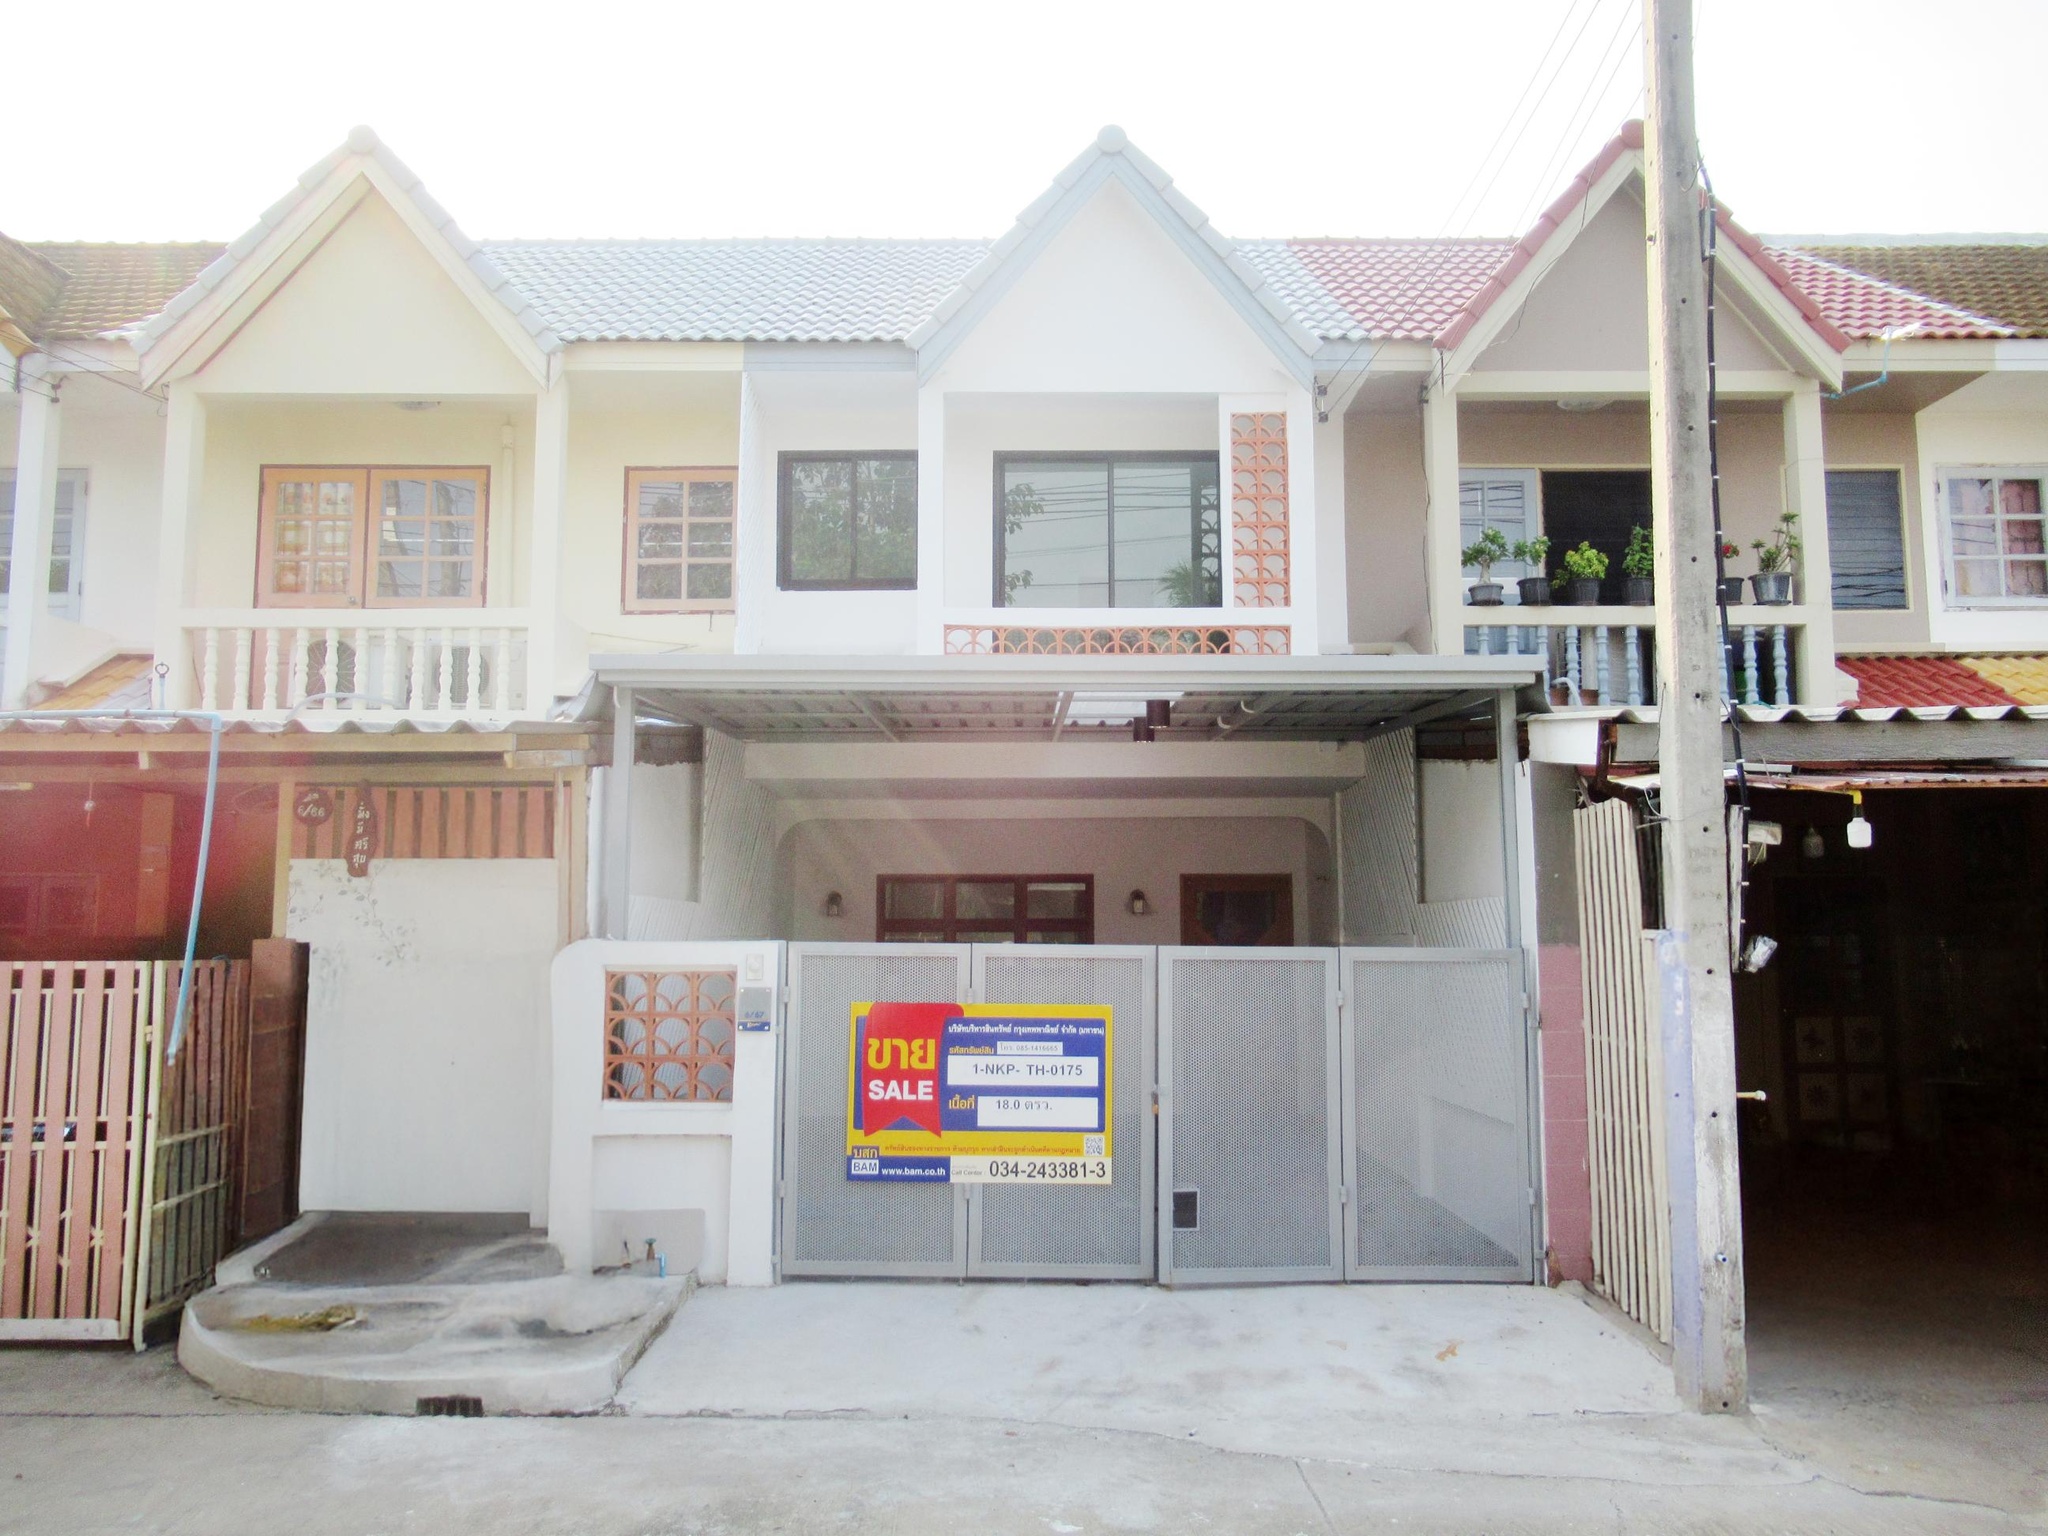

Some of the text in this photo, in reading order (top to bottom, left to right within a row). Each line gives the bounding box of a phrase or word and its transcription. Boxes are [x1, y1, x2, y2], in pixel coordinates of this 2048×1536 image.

[1061, 1024, 1077, 1034] จำกัด
[1078, 1026, 1105, 1037] (มหาชน)
[867, 1038, 935, 1069] ขาย
[1026, 1064, 1083, 1076] TH-0175
[868, 1079, 933, 1101] SALE
[948, 1094, 976, 1110] เนื้อที่
[996, 1099, 1020, 1110] 18.0
[853, 1161, 877, 1173] BAM
[881, 1166, 946, 1176] www.bam.co.th
[989, 1160, 1106, 1179] 034-243381-3
